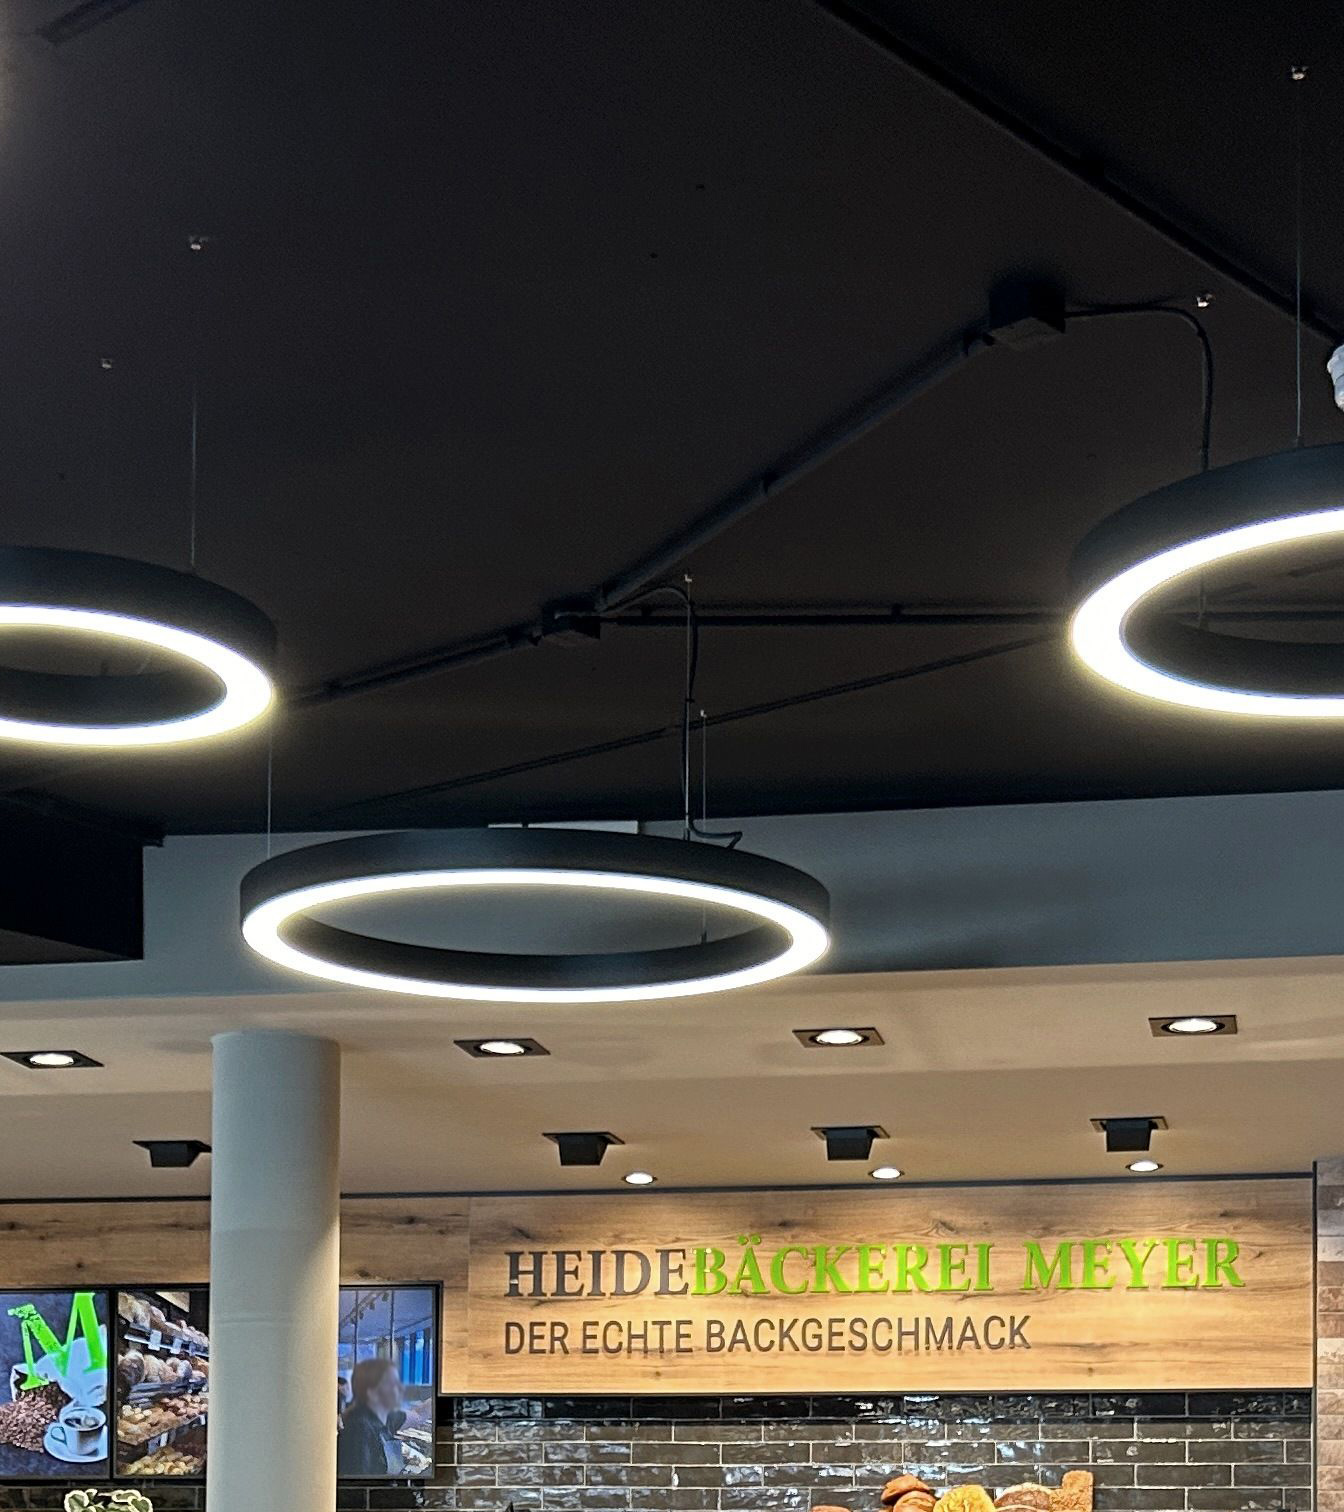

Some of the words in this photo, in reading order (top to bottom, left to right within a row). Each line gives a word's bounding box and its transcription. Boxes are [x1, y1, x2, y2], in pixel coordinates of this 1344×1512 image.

[1022, 1238, 1246, 1290] MEYER
[505, 1320, 570, 1355] DER
[582, 1319, 693, 1354] ECHTE
[706, 1315, 1031, 1353] BACKGESCHMACK
